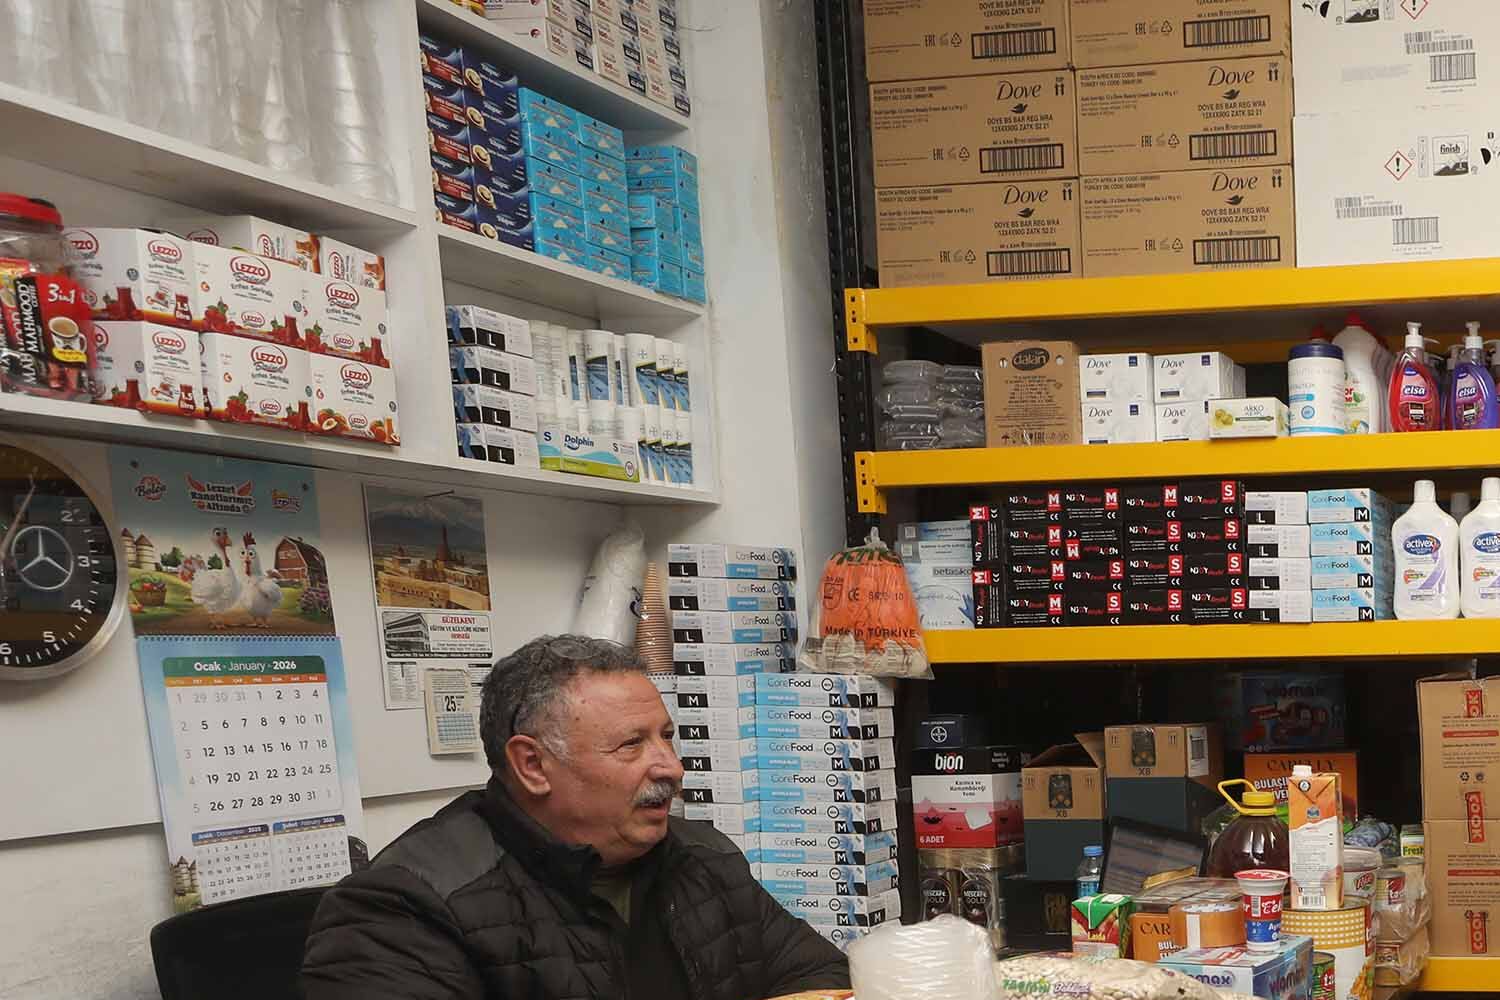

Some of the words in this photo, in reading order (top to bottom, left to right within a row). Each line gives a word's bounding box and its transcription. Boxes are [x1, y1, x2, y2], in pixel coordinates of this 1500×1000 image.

[1207, 65, 1255, 86] Dove
[997, 80, 1042, 101] Dove
[1440, 144, 1461, 155] finish
[1212, 173, 1258, 193] Dove
[1003, 185, 1048, 205] Dove
[151, 244, 180, 259] LEZZO
[234, 262, 266, 277] LEZZO
[47, 284, 76, 305] 3in1
[330, 288, 357, 301] LEZZO
[255, 351, 285, 366] LEZZO
[1086, 357, 1113, 370] Dove
[344, 369, 370, 385] LEZZO
[1402, 383, 1427, 398] elsa
[1457, 385, 1478, 399] elsa
[1088, 405, 1114, 419] Dove
[544, 431, 552, 442] S
[564, 434, 595, 448] Dolphin
[1405, 538, 1434, 550] activex
[78, 555, 90, 567] 3
[71, 599, 83, 610] 4
[43, 631, 55, 643] 5
[194, 661, 222, 672] Ocak
[228, 661, 267, 674] January
[273, 661, 297, 671] 2026
[445, 695, 457, 713] 25
[831, 695, 841, 705] M
[208, 774, 219, 784] 19
[227, 772, 241, 783] 20
[248, 770, 259, 780] 21
[266, 769, 279, 779] 22
[284, 767, 297, 777] 23
[302, 765, 314, 775] 24
[319, 763, 332, 774] 25
[926, 835, 945, 844] ADET
[1403, 845, 1425, 857] Fresh
